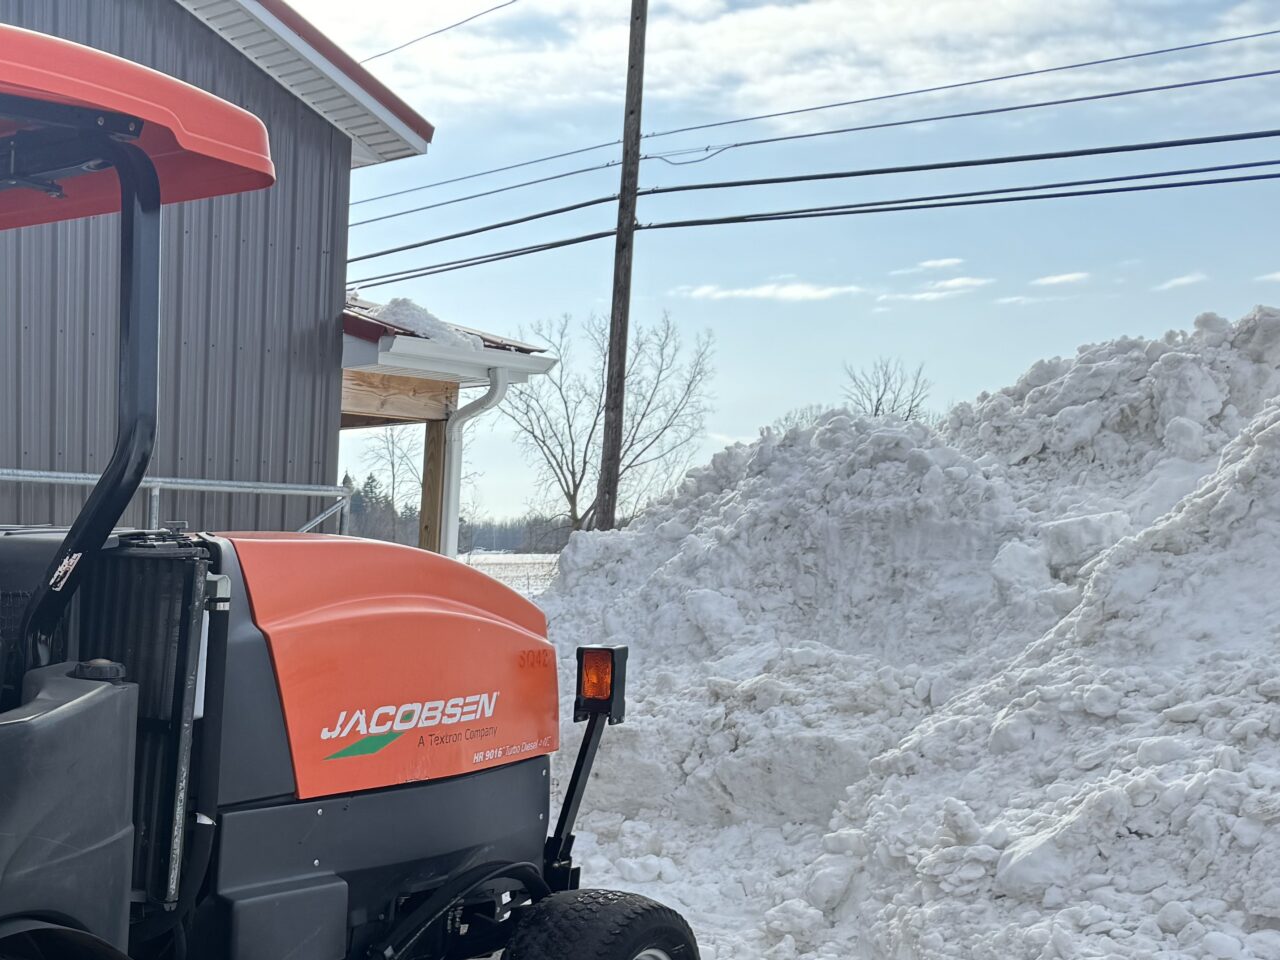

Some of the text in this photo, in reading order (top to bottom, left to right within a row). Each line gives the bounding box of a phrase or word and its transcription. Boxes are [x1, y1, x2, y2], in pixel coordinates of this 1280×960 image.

[320, 692, 497, 740] JACOBSEN
[417, 726, 498, 748] A Textron Company
[473, 751, 485, 764] HR
[505, 745, 521, 756] Turbo
[521, 739, 539, 753] Diesel
